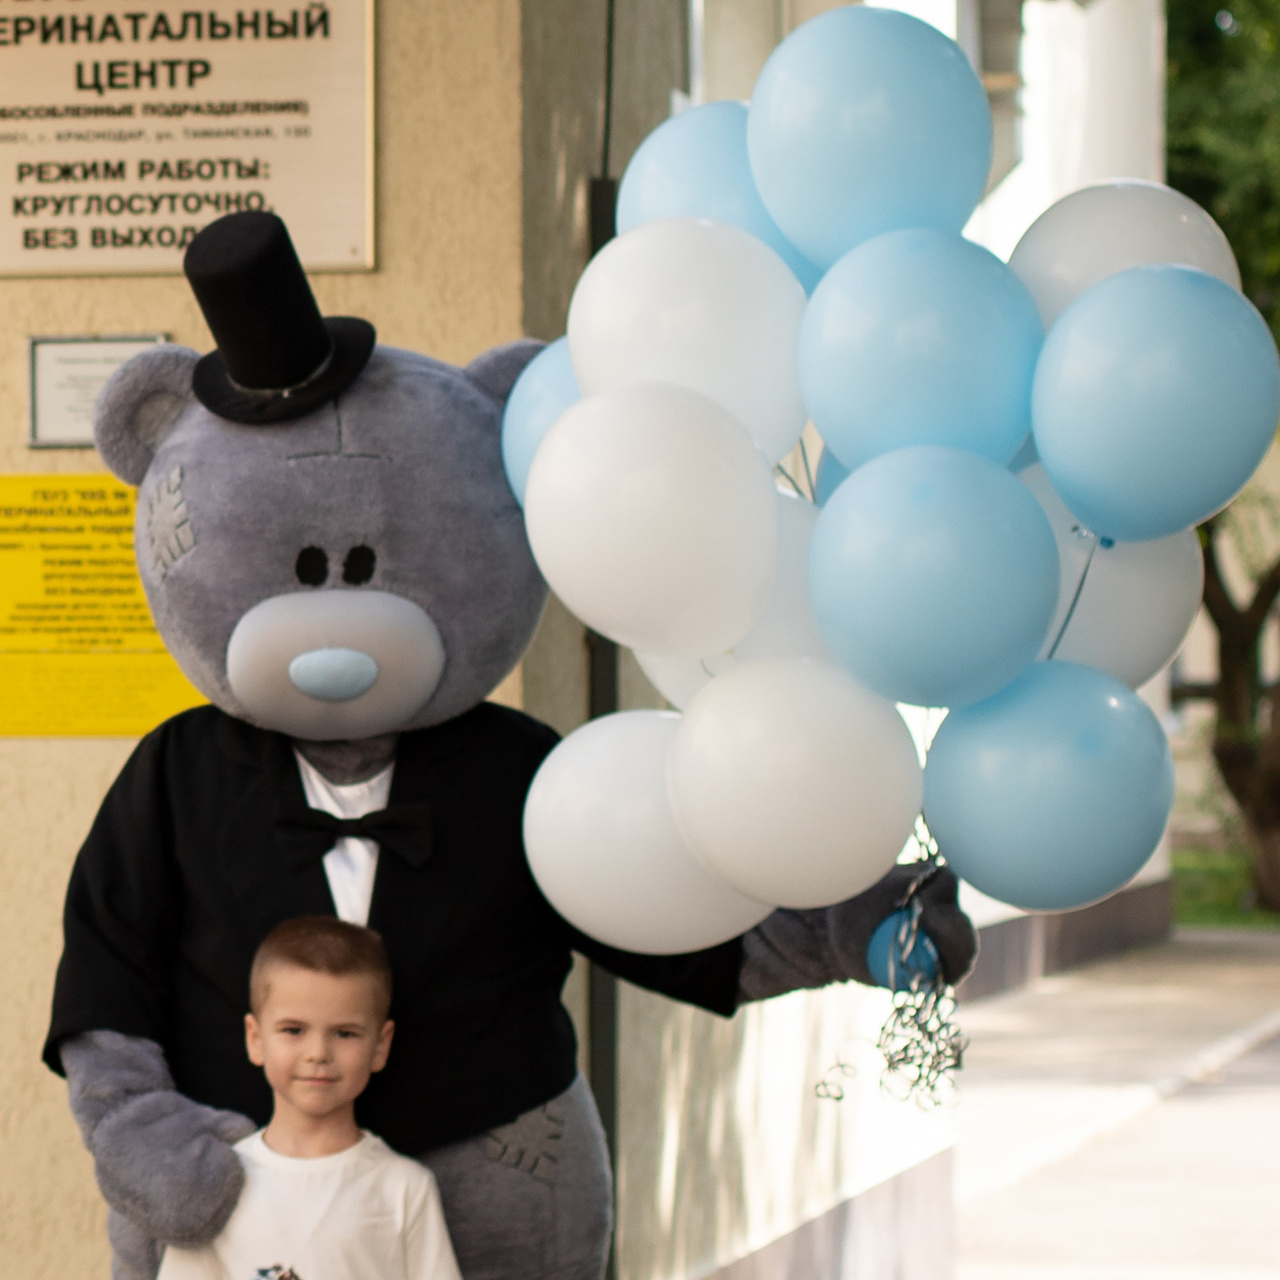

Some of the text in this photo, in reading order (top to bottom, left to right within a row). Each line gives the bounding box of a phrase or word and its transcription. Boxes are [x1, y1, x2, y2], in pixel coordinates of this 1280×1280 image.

[75, 58, 212, 95] ЦЕНТР
[17, 158, 270, 183] РЕЖИМ РАБОТЫ:
[23, 226, 197, 251] БЕЗ ВЫХОД
